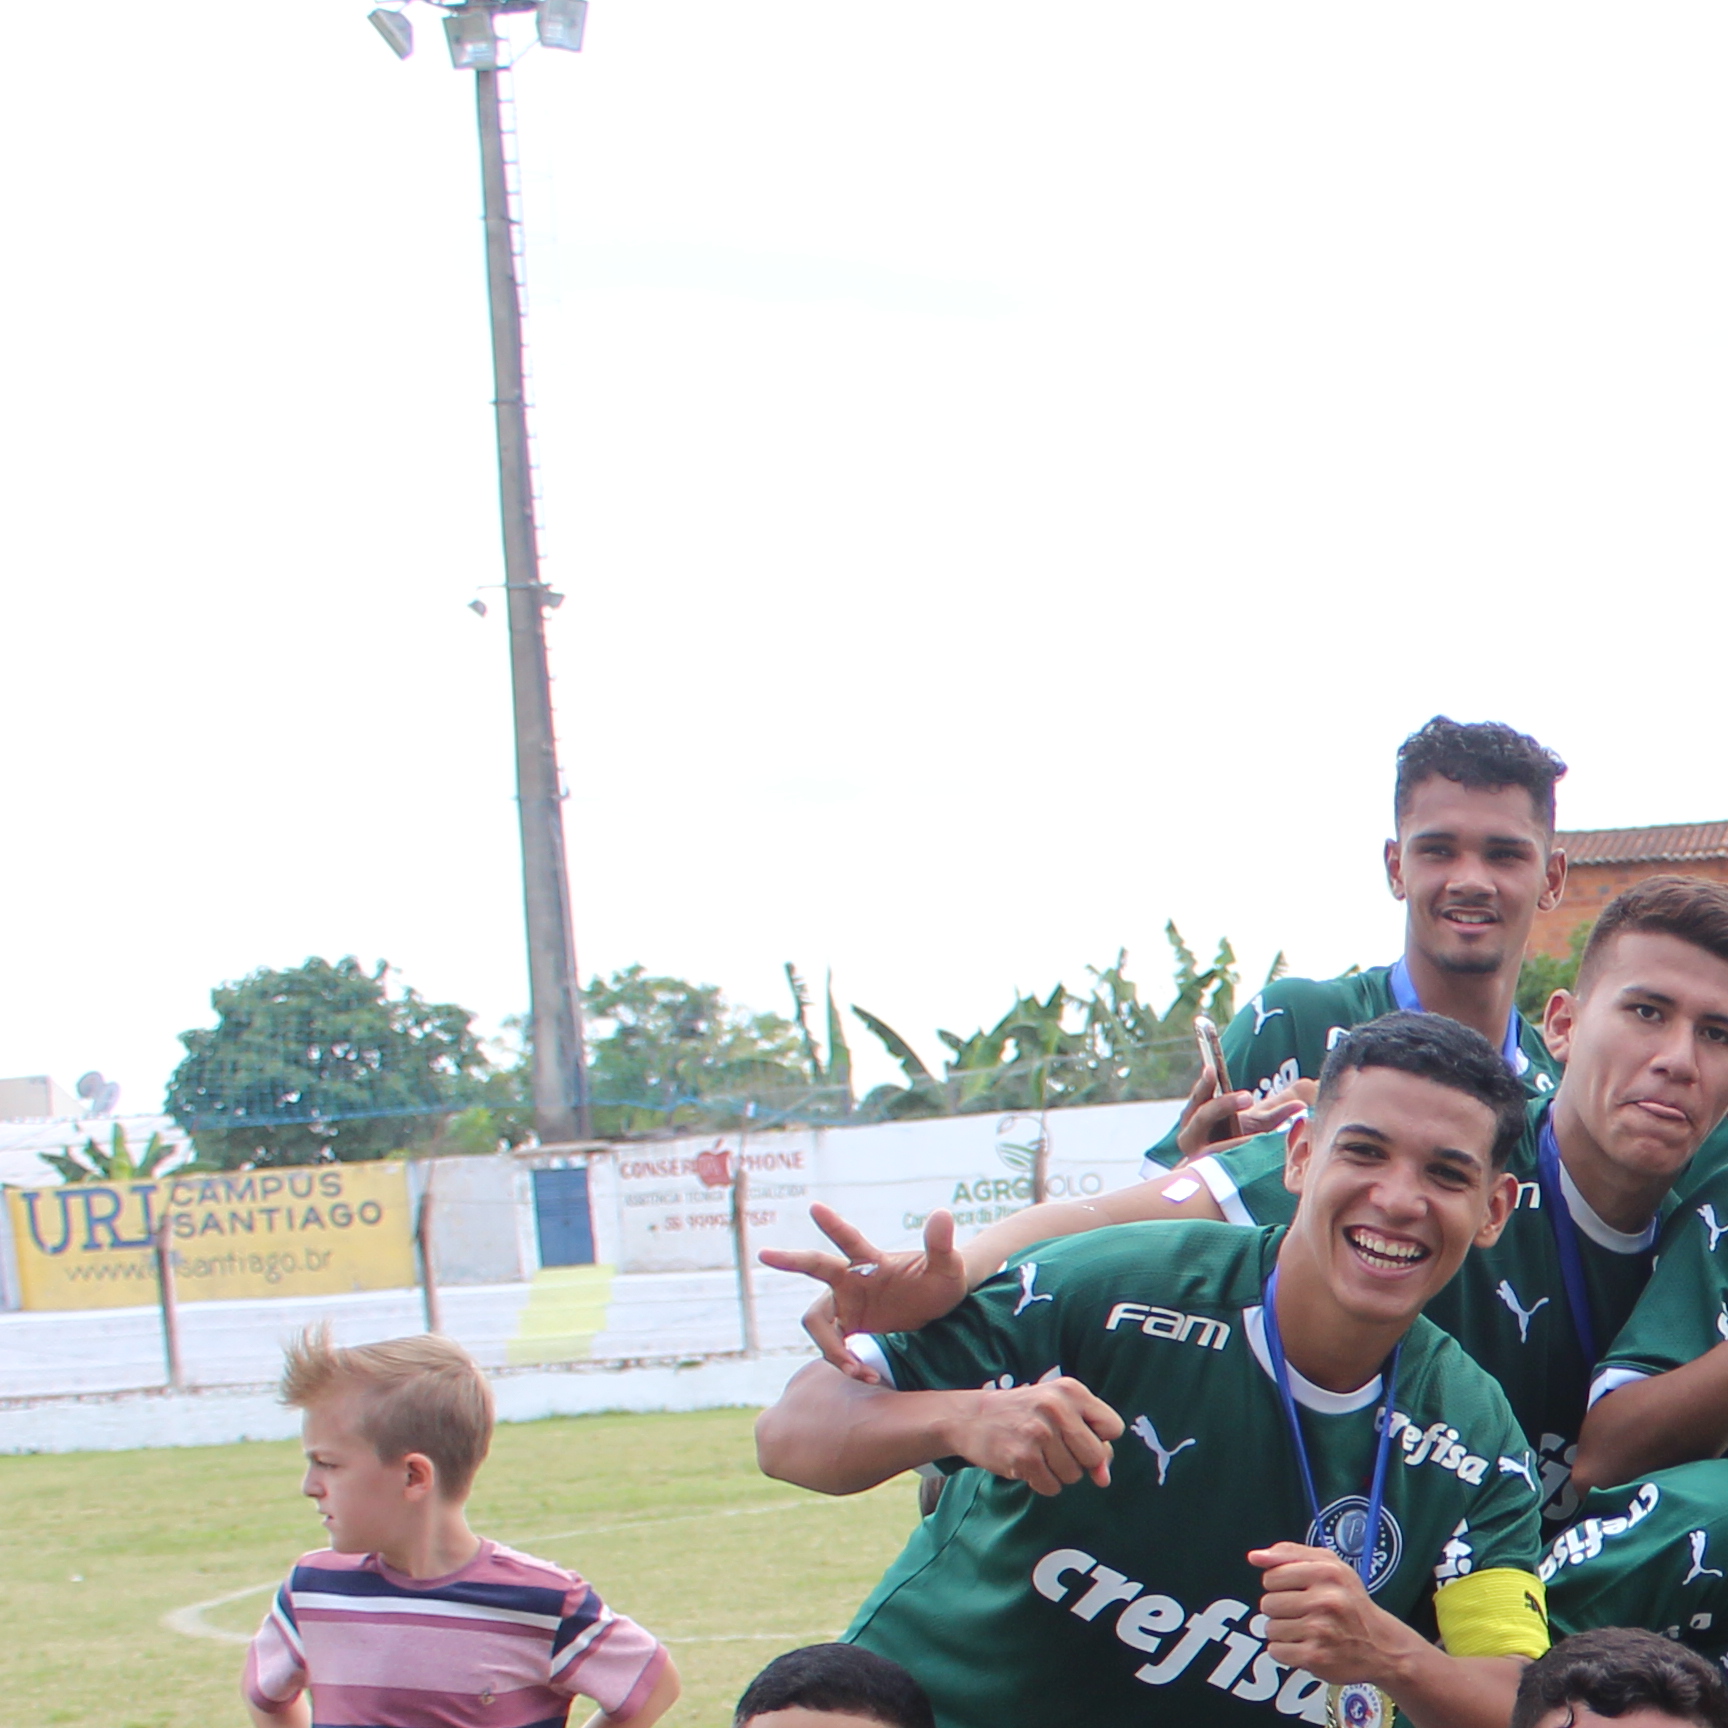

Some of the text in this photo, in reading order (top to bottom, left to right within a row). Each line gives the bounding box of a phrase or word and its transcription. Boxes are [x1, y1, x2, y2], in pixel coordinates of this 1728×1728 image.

[171, 1171, 344, 1207] CAMPUS
[952, 1172, 1103, 1204] AGROOLO
[21, 1185, 167, 1255] URI
[172, 1200, 383, 1239] SANTIAGO
[1538, 1481, 1660, 1583] crefisa
